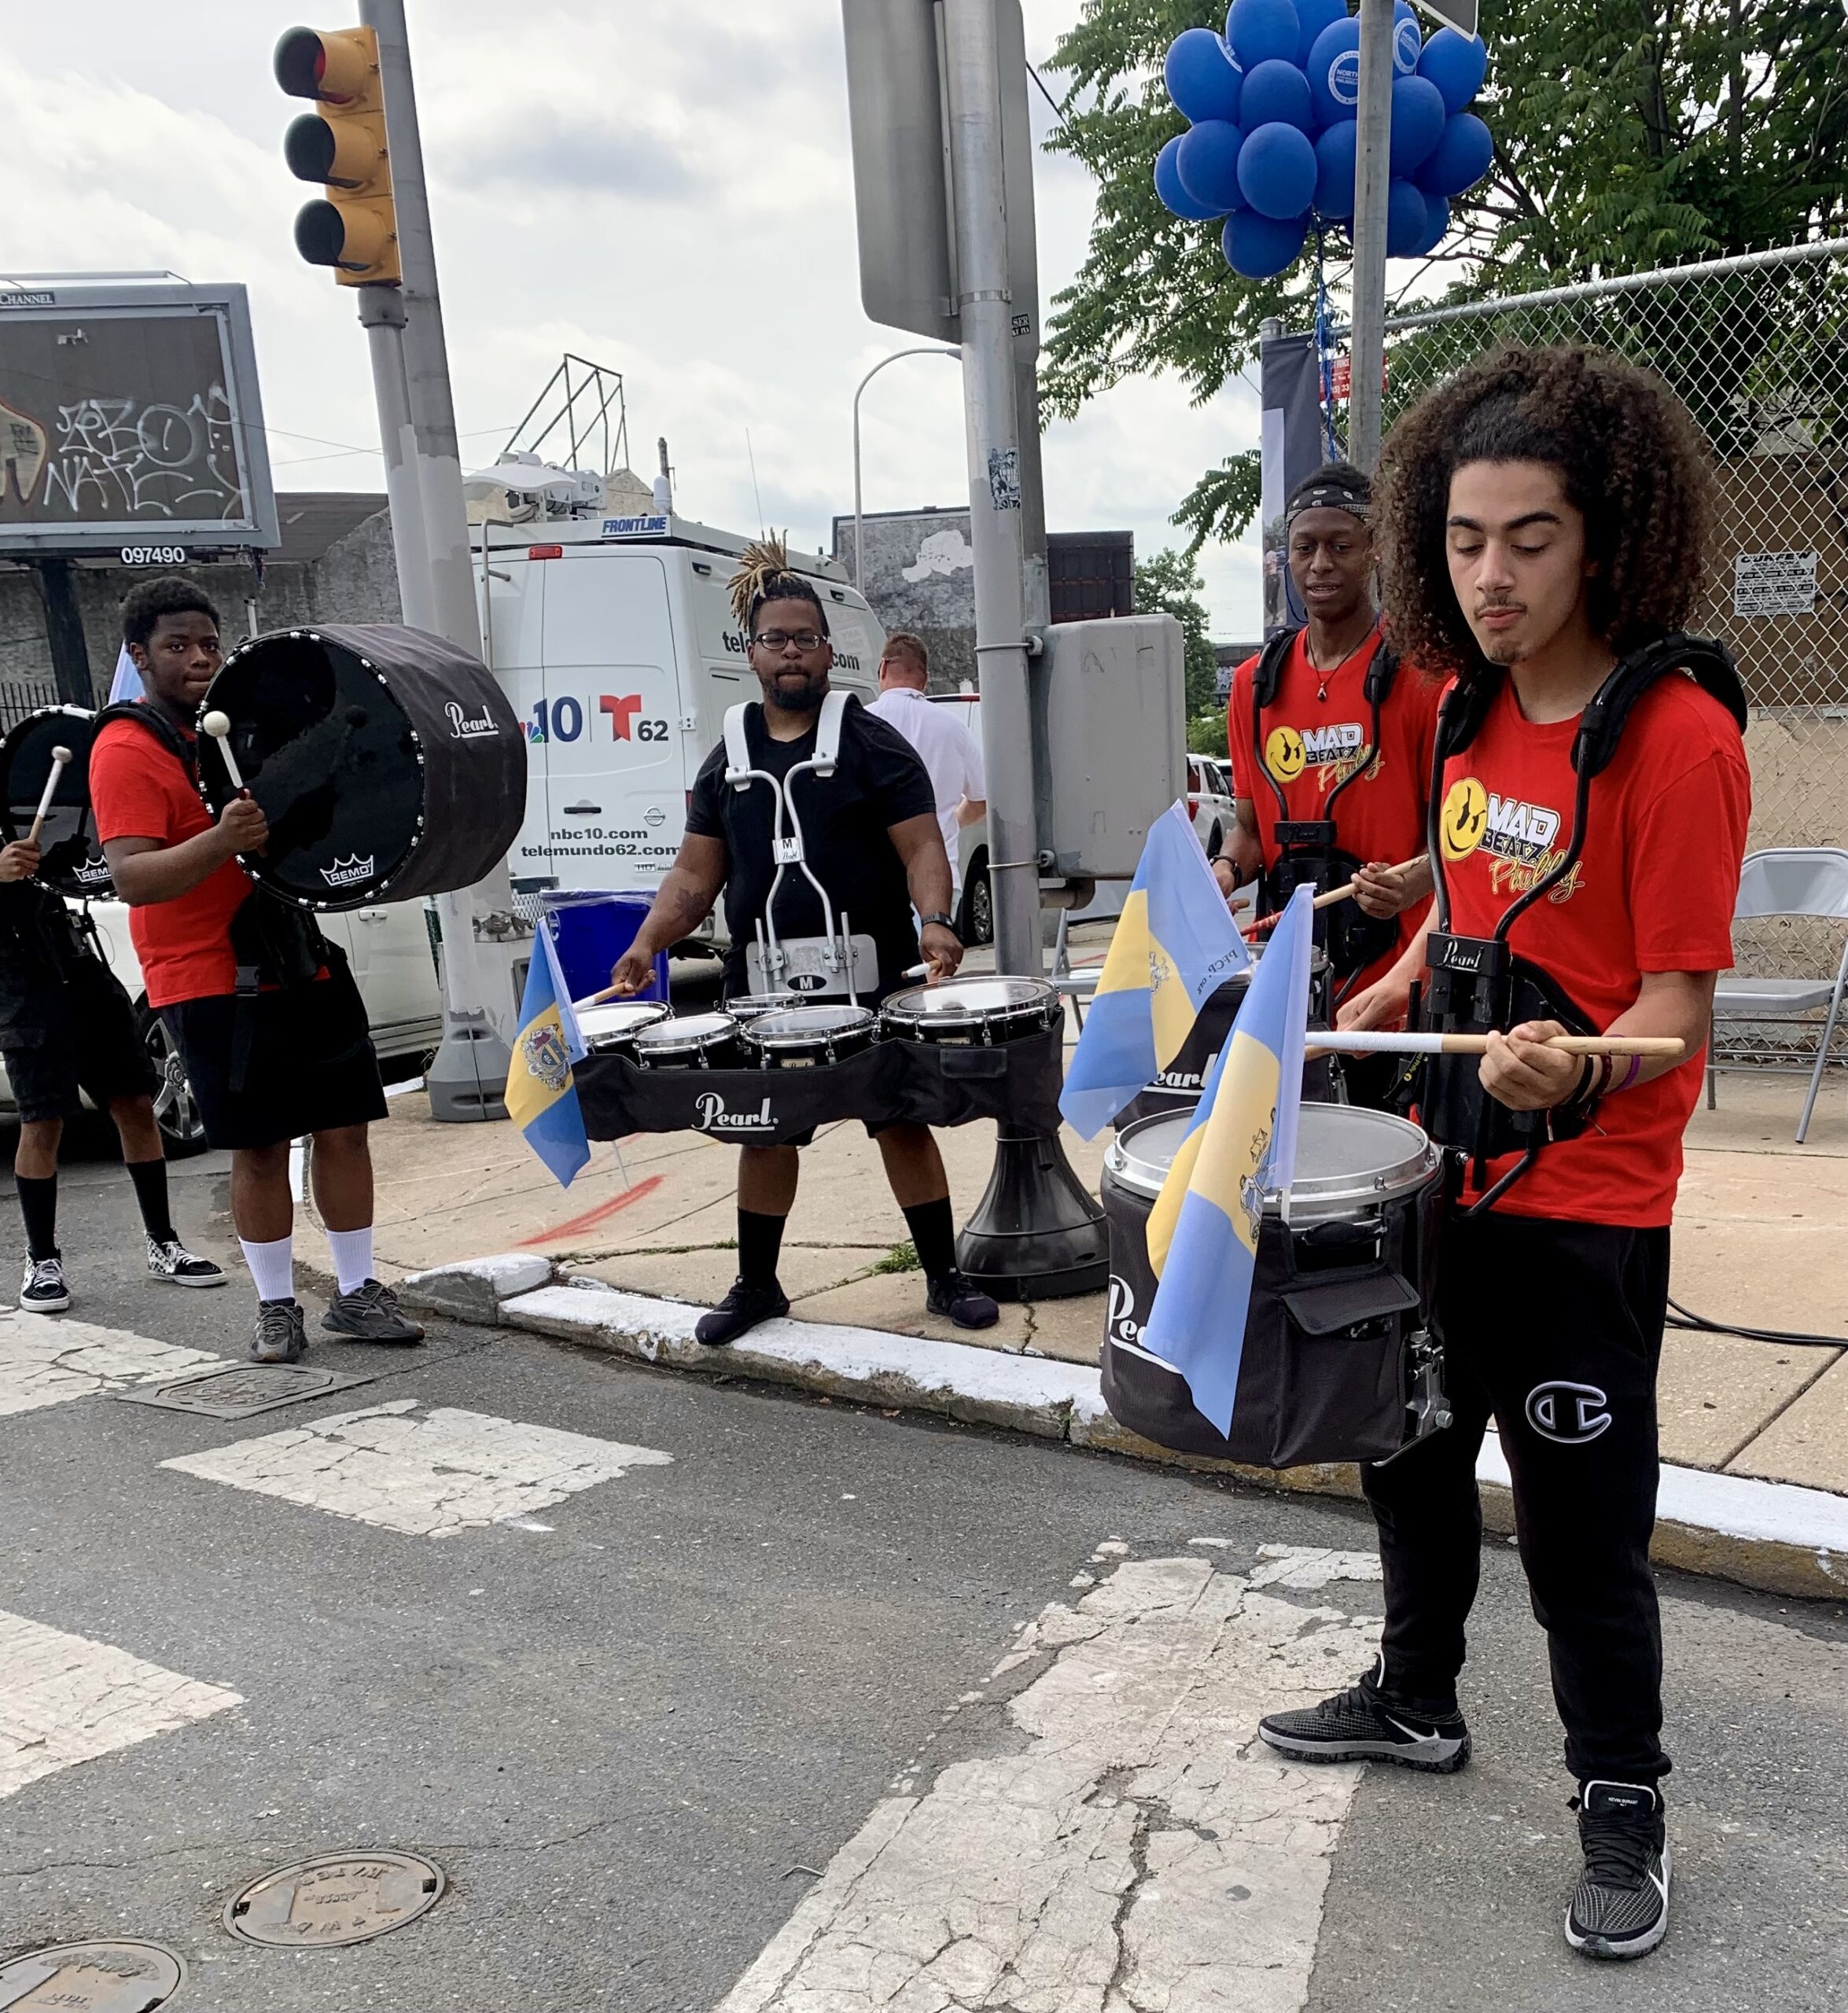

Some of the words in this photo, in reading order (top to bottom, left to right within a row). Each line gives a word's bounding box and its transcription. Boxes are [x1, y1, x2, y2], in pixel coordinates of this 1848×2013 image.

[0, 293, 53, 305] CHANNEL
[602, 516, 668, 533] FRONTLINE
[121, 547, 186, 564] 097490
[444, 701, 499, 738] Pearl
[533, 696, 583, 742] 10
[638, 720, 668, 742] 62
[1301, 724, 1362, 752] MAD
[1305, 745, 1359, 764] BEATZ
[1485, 794, 1559, 846] MAD
[550, 828, 649, 840] nbc10.com
[521, 845, 681, 856] telemundo62.com
[1480, 827, 1551, 863] BEATZ
[81, 867, 109, 879] REM
[330, 865, 370, 882] REMO
[1437, 939, 1485, 973] Pearl
[799, 977, 814, 990] M
[1153, 1053, 1219, 1088] earl
[690, 1091, 775, 1132] Pearl
